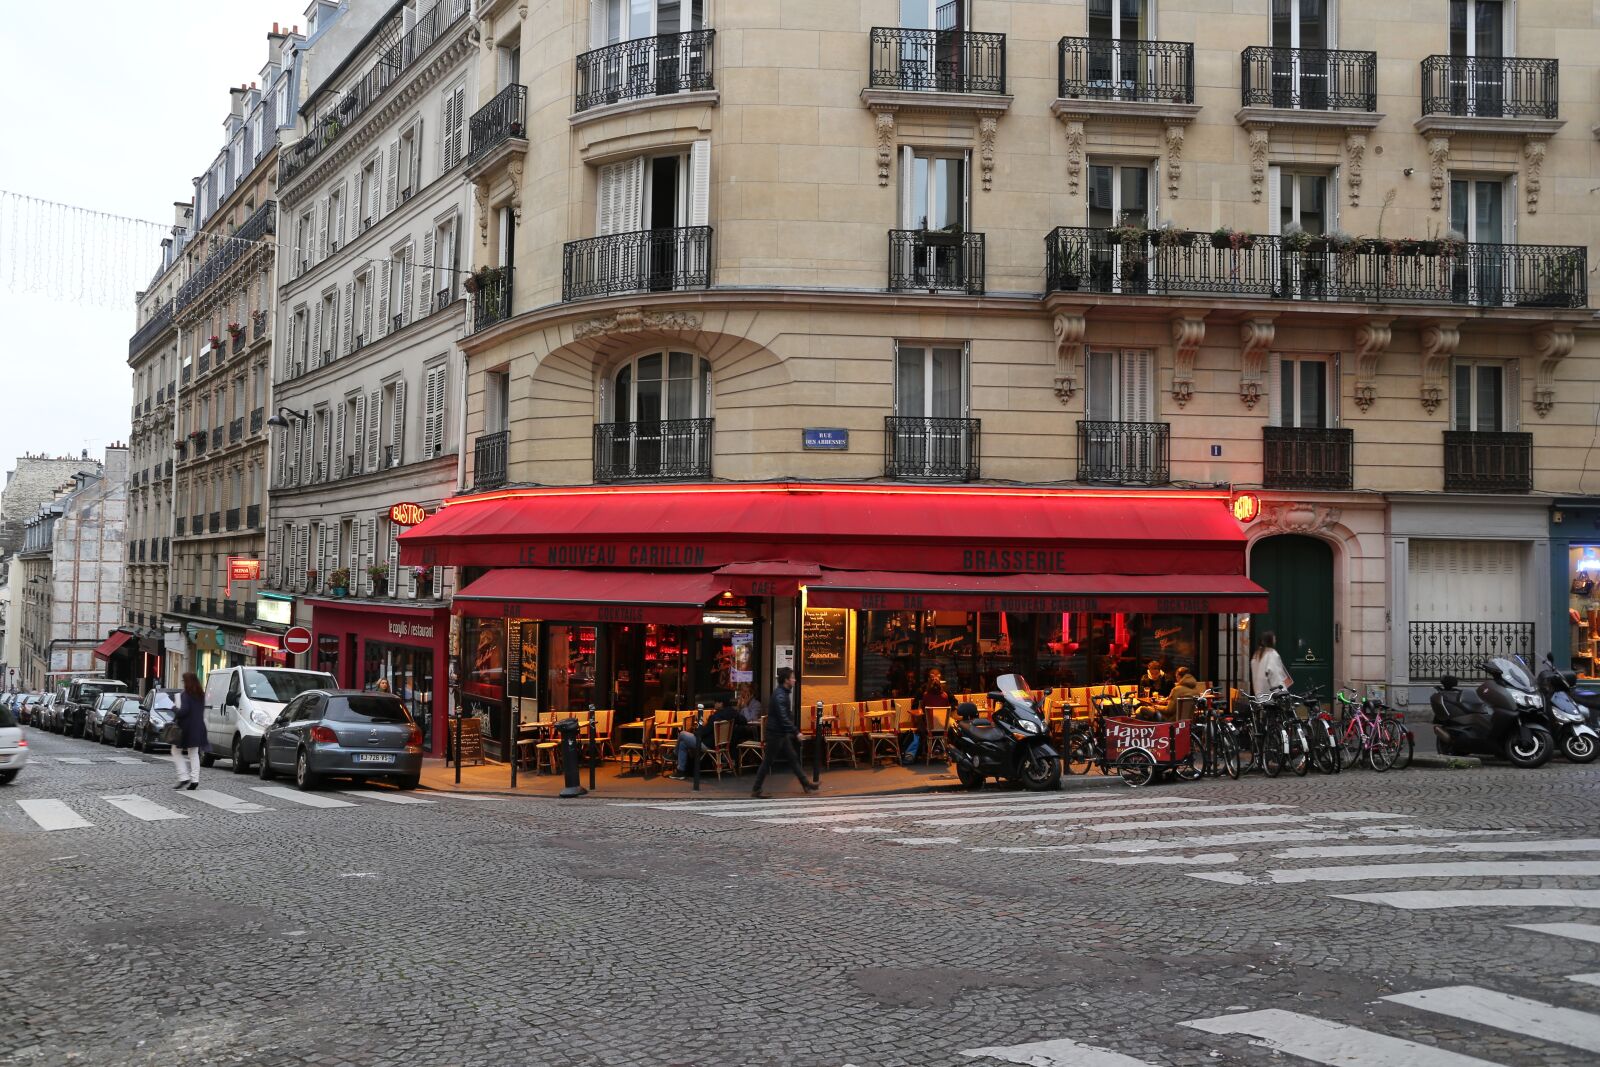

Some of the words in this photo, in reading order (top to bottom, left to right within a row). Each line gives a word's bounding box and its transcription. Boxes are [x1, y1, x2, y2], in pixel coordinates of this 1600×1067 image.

[393, 503, 425, 524] BISTRO
[519, 545, 536, 565] LE
[548, 544, 616, 565] NOUVEAU
[629, 545, 705, 566] CARILLON
[963, 550, 1067, 572] BRASSERIE
[410, 623, 434, 638] restaurant
[1106, 725, 1156, 738] Happy
[1117, 736, 1170, 749] Hours
